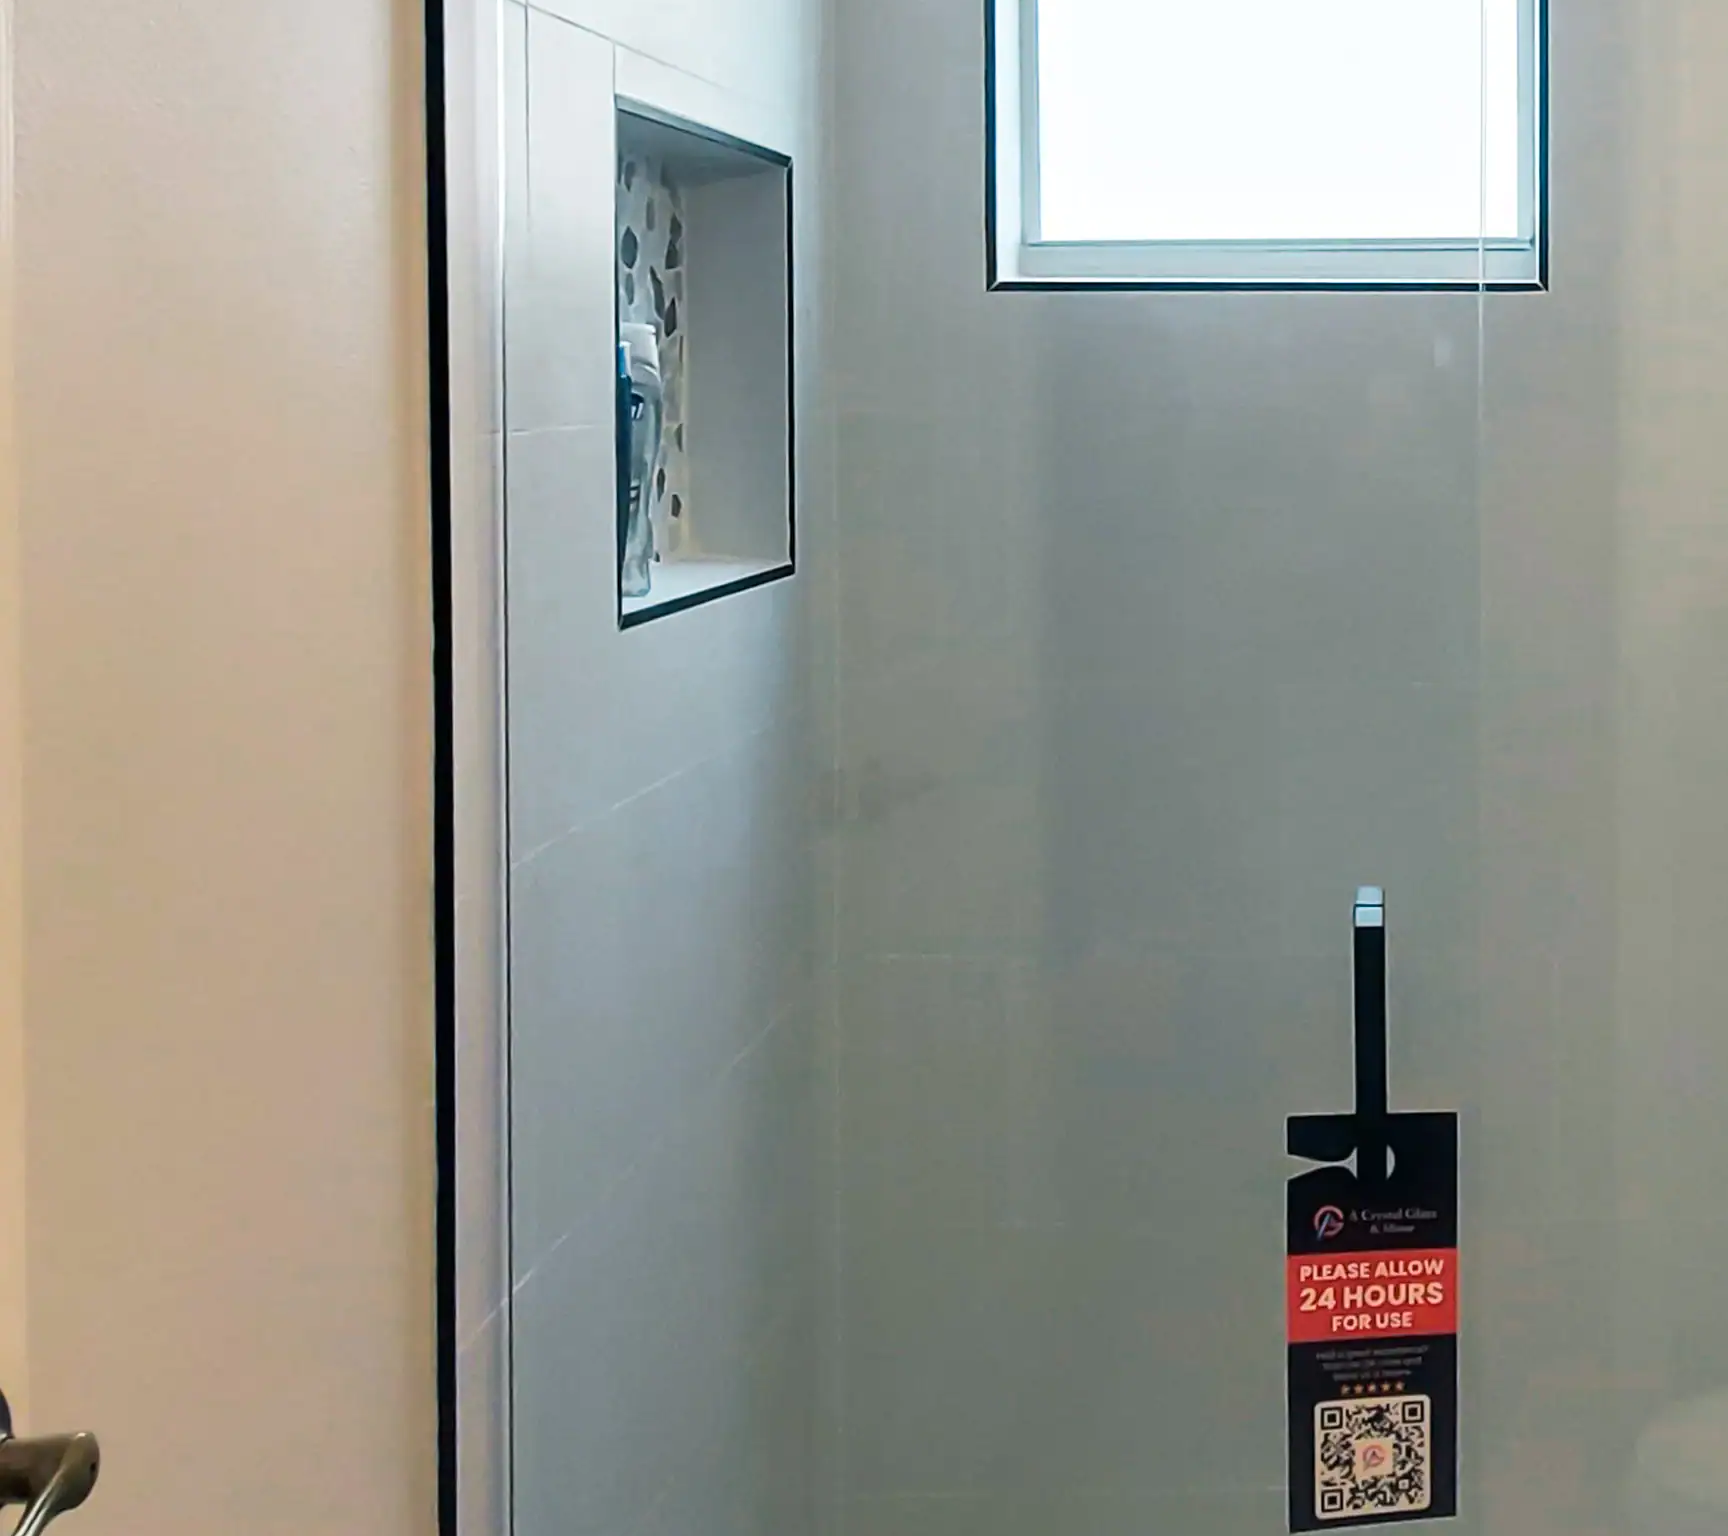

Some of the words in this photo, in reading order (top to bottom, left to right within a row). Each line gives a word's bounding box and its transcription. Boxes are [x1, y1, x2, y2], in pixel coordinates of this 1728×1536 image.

[1300, 1262, 1370, 1282] PLEASE
[1375, 1259, 1444, 1277] ALLOW
[1300, 1287, 1336, 1311] 24
[1343, 1282, 1444, 1309] HOURS
[1332, 1315, 1371, 1332] FOR
[1376, 1312, 1412, 1329] USE
